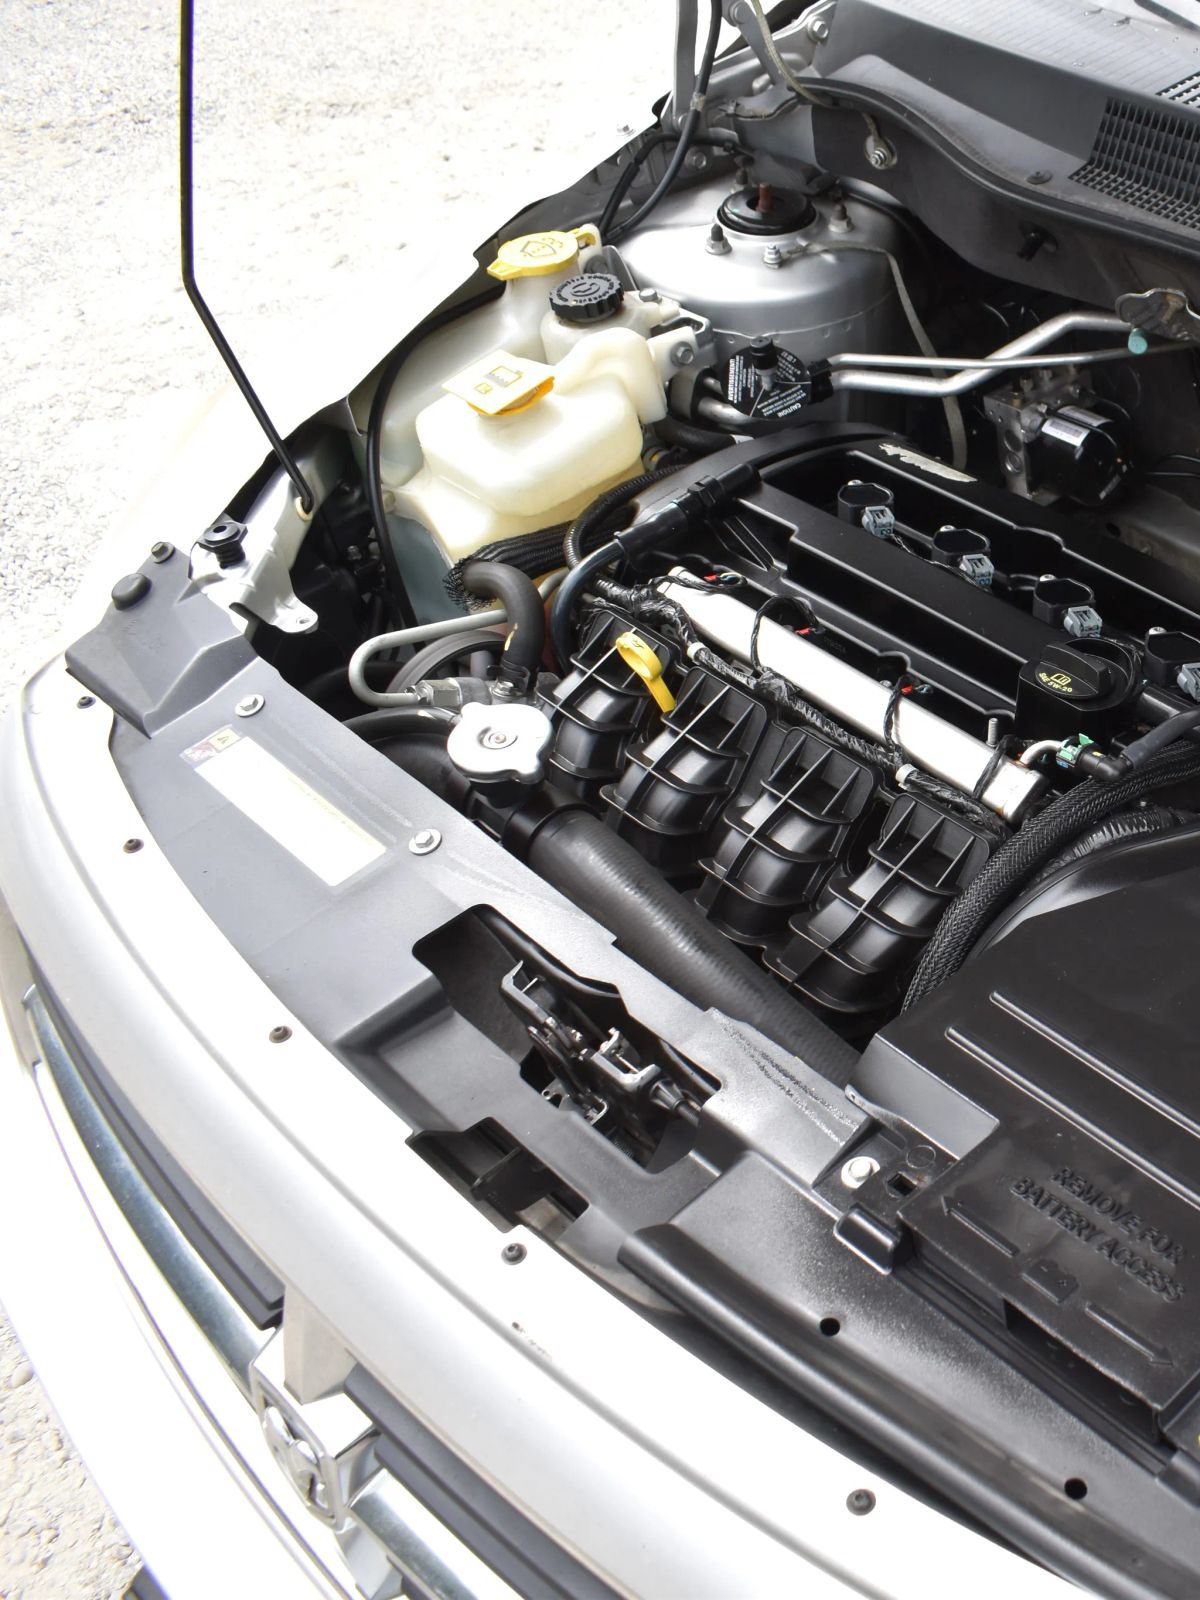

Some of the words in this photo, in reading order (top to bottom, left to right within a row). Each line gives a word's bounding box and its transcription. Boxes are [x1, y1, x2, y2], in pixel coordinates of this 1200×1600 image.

[1009, 1175, 1100, 1245] BATTERY
[1096, 1236, 1186, 1303] ACCESS
[1052, 1167, 1143, 1236] REMOVE
[1138, 1226, 1187, 1267] FOR
